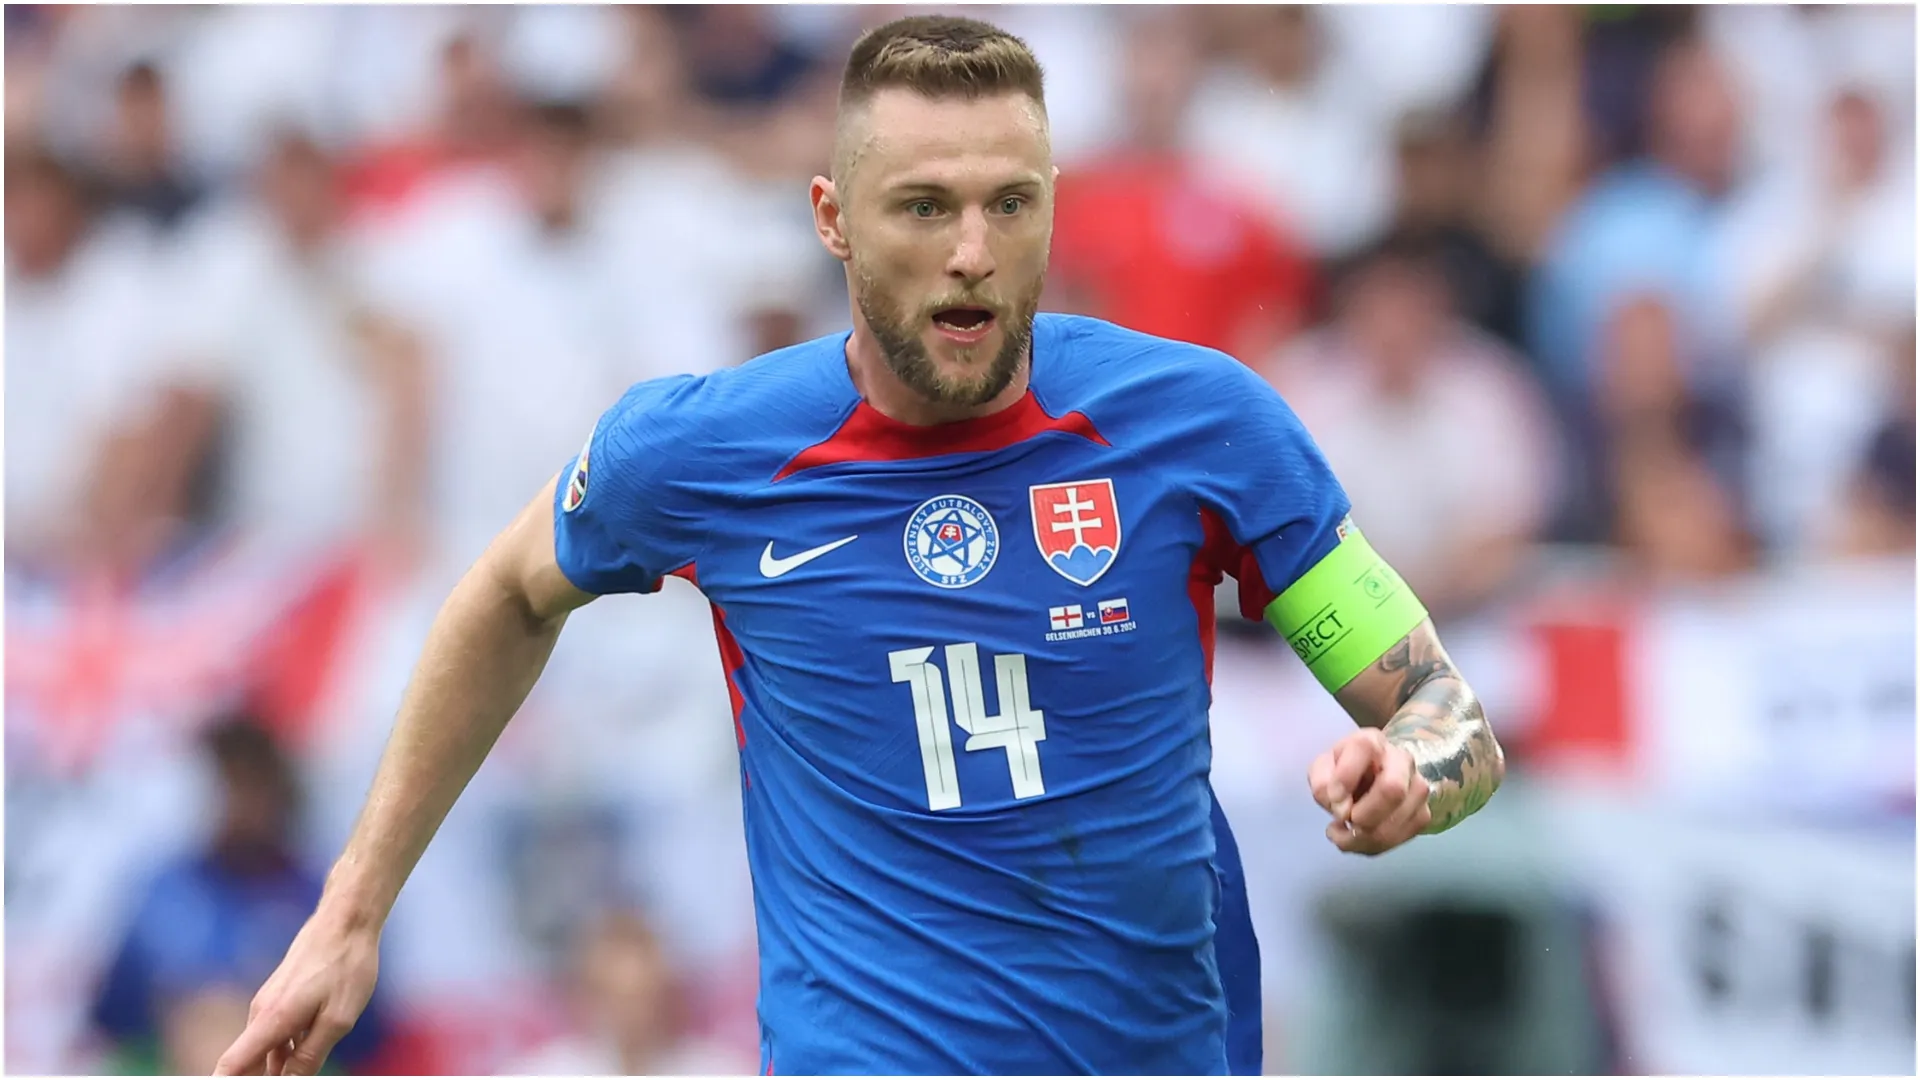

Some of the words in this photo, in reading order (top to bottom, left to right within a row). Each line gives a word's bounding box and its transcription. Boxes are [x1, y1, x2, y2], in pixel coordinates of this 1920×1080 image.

[941, 575, 968, 584] SFZ
[1045, 627, 1101, 642] GELSENKIRCHEN
[888, 642, 1047, 812] 14
